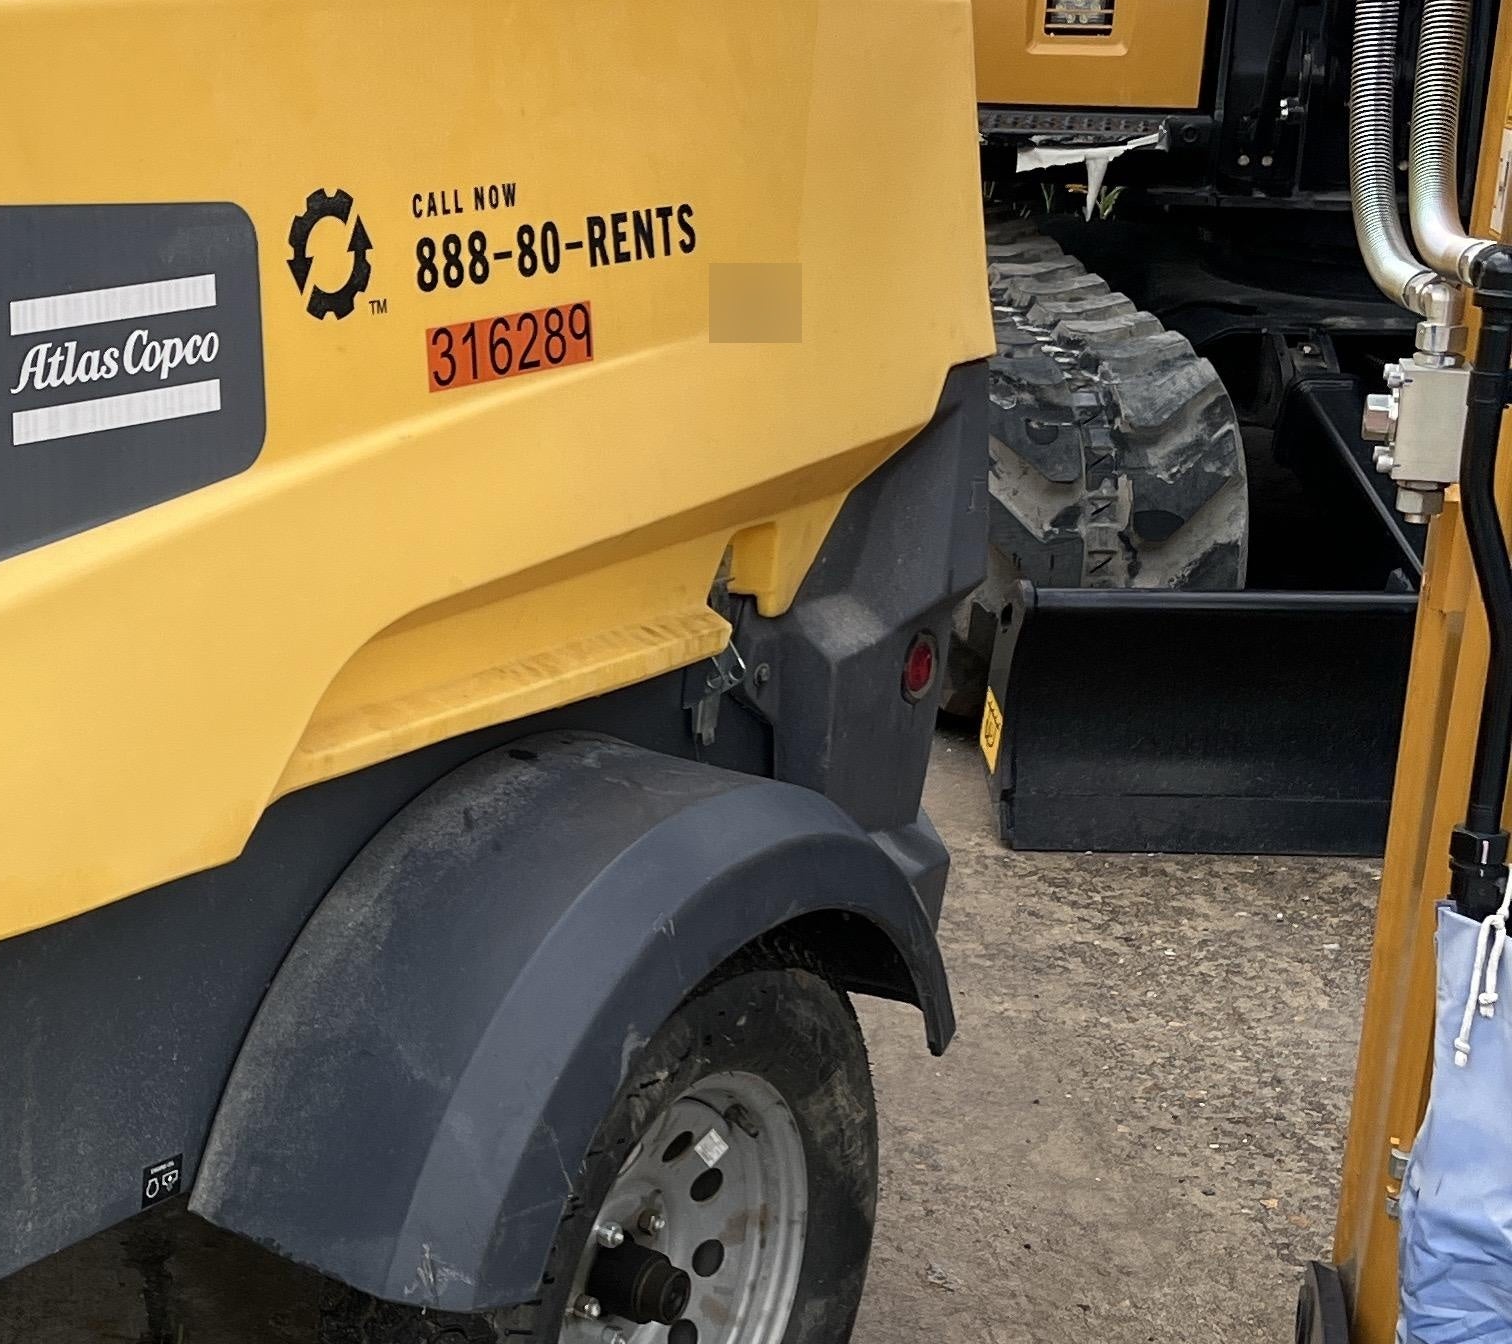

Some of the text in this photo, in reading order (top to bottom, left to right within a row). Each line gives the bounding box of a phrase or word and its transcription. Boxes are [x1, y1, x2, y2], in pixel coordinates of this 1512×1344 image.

[412, 182, 517, 219] CALL NOW
[415, 203, 697, 293] 888-80-RENTS
[431, 302, 593, 387] 316289
